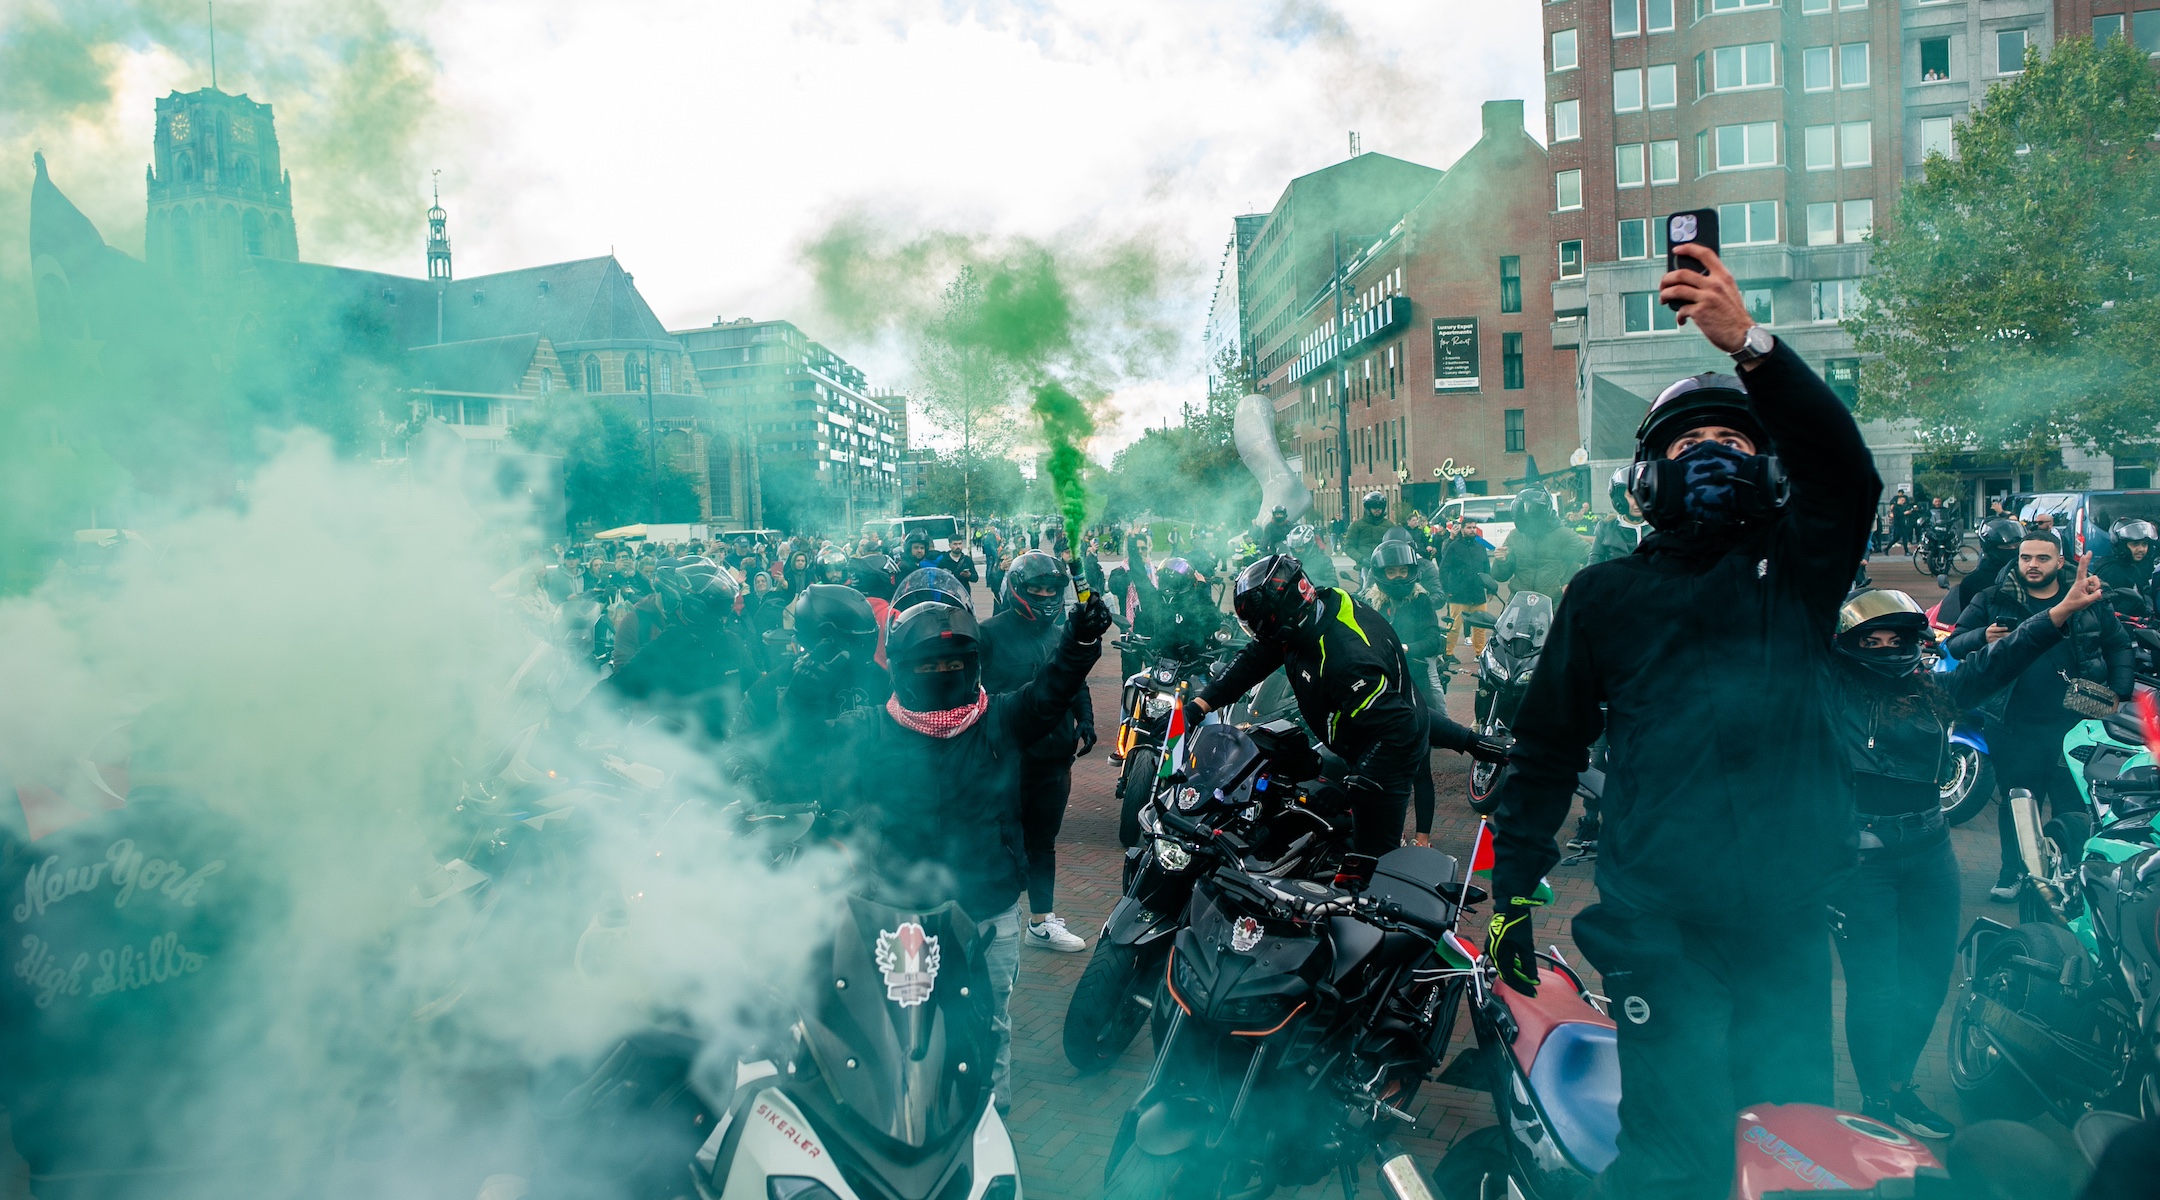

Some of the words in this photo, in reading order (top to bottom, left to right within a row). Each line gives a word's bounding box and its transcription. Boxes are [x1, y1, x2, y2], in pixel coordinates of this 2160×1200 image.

[1439, 338, 1450, 349] for
[1451, 336, 1471, 346] Rent
[1433, 457, 1475, 481] Loetje
[13, 855, 108, 923] New
[105, 838, 227, 908] York
[14, 934, 90, 1009] High
[88, 931, 209, 998] Skills
[756, 1103, 821, 1159] SIKERLER
[1743, 1124, 1854, 1190] SUZUK
